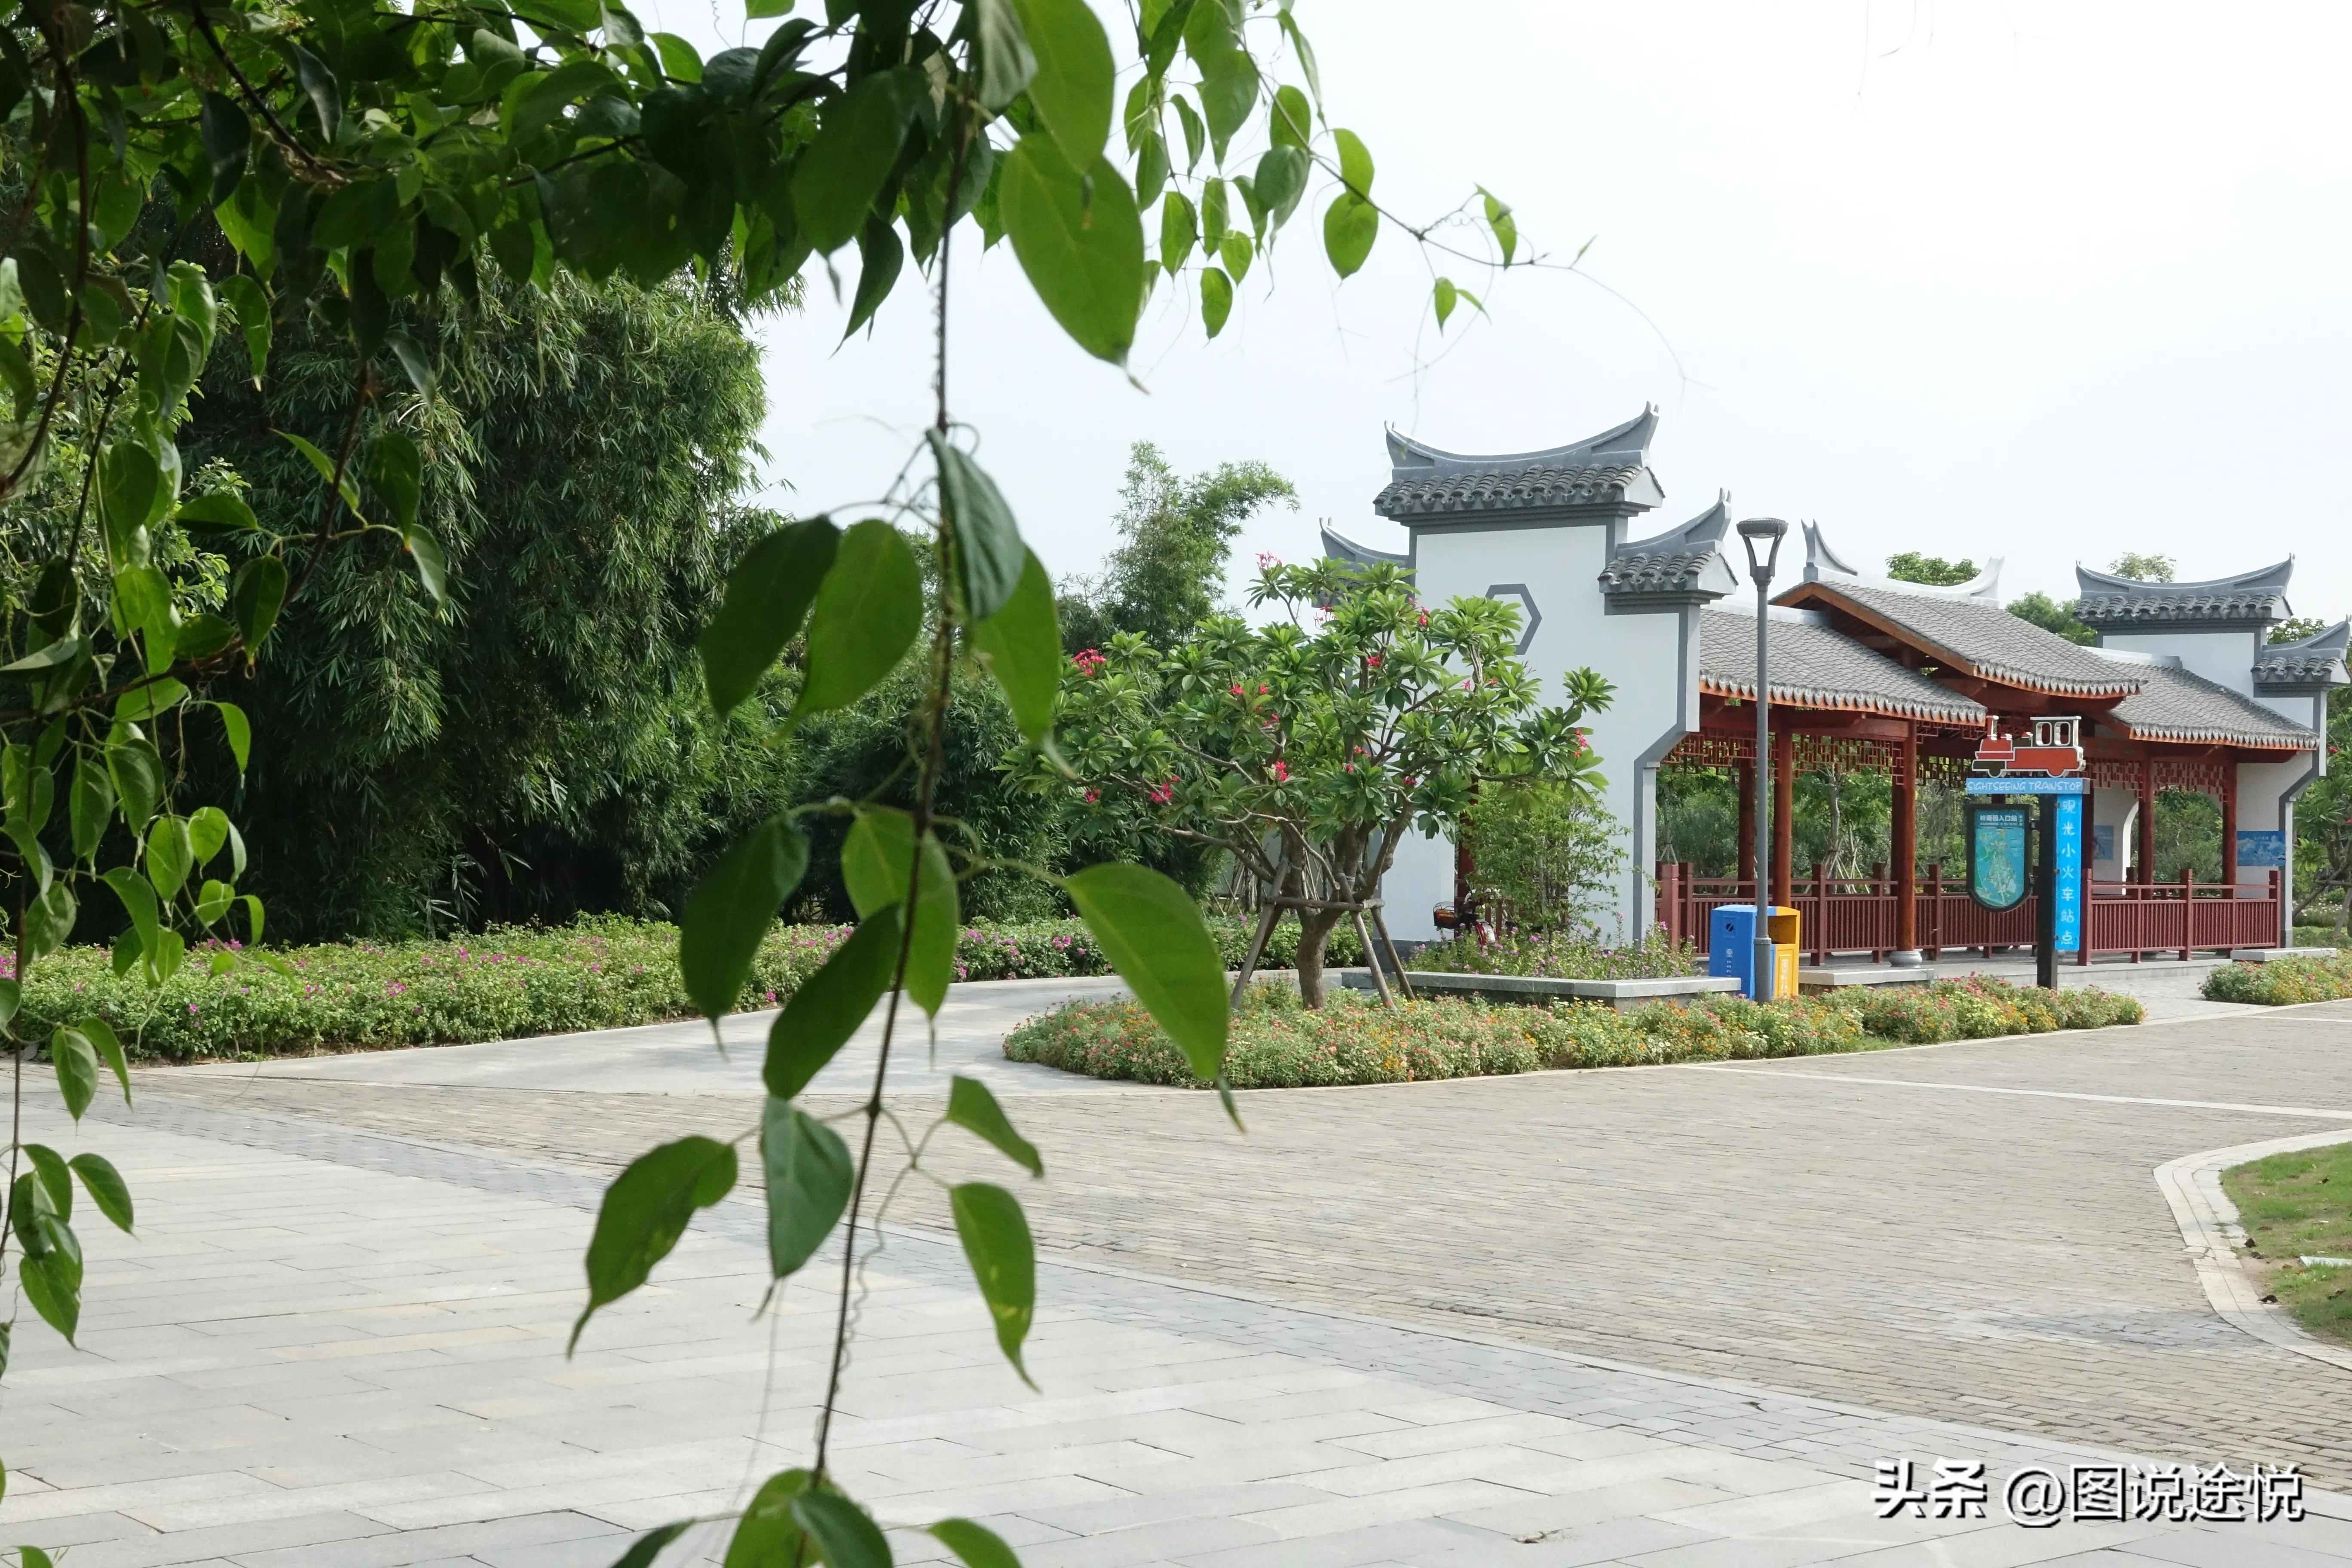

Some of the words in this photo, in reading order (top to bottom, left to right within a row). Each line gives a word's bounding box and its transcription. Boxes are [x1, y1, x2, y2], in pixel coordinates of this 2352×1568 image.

[1967, 781, 2026, 790] SIGHTSEEING
[2061, 799, 2076, 945] 观光小火车站点
